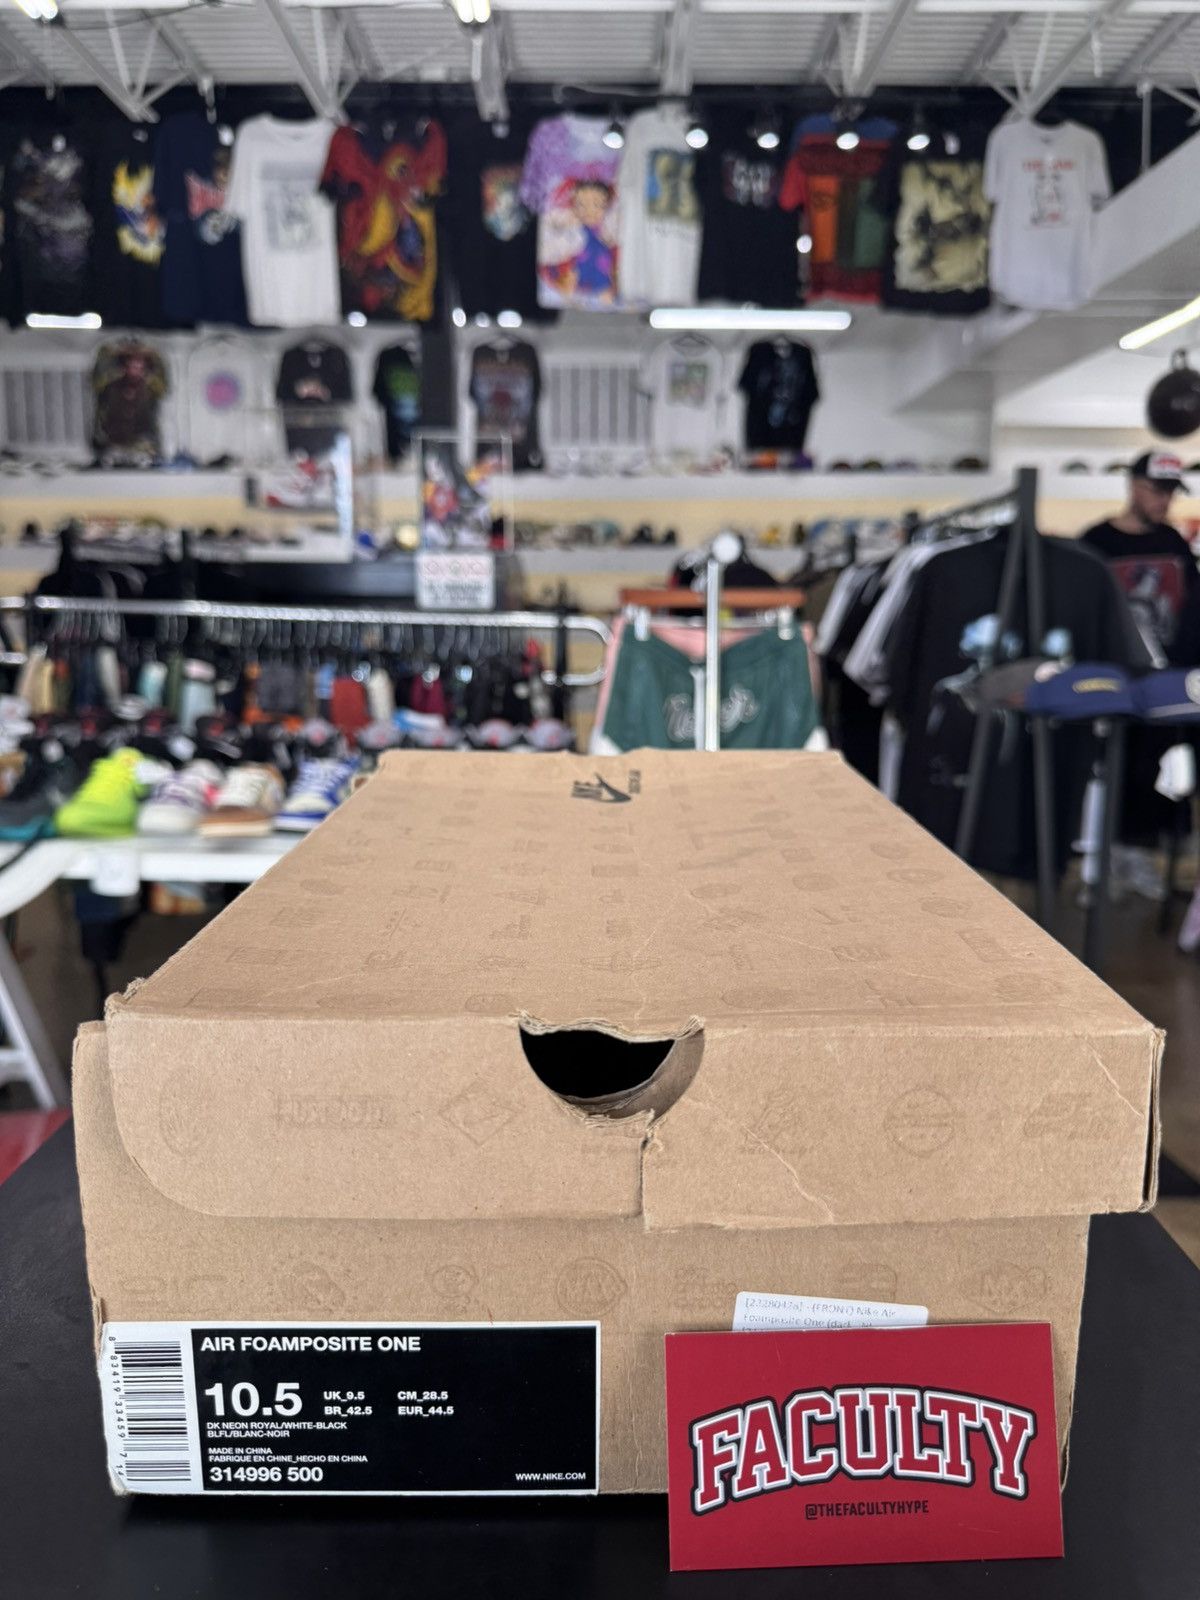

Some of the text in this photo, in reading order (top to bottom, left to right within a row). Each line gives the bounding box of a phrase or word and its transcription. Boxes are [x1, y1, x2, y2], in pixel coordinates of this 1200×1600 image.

[201, 1336, 422, 1352] AIR FOAMPOSITE ONE
[204, 1381, 303, 1417] 10.5
[323, 1391, 366, 1402] UK_9.5
[397, 1391, 449, 1402] CM_28.5
[324, 1405, 373, 1417] BR_42.5
[397, 1405, 455, 1417] EUR_44.5
[206, 1422, 348, 1430] DK NEON ROYAL/WHITE-BLACK
[207, 1430, 290, 1438] BLFL/BLANC-NOIR
[208, 1447, 273, 1455] MADE IN CHINA
[690, 1384, 1036, 1515] FACULTY
[209, 1455, 252, 1463] FABRIQUE
[253, 1455, 265, 1463] EN
[327, 1455, 340, 1463] EN
[341, 1455, 368, 1463] CHINA
[210, 1466, 324, 1482] 314996 500
[515, 1472, 586, 1481] WWW.NIKE.COM
[804, 1499, 930, 1520] @THEFACULTYHYPE
